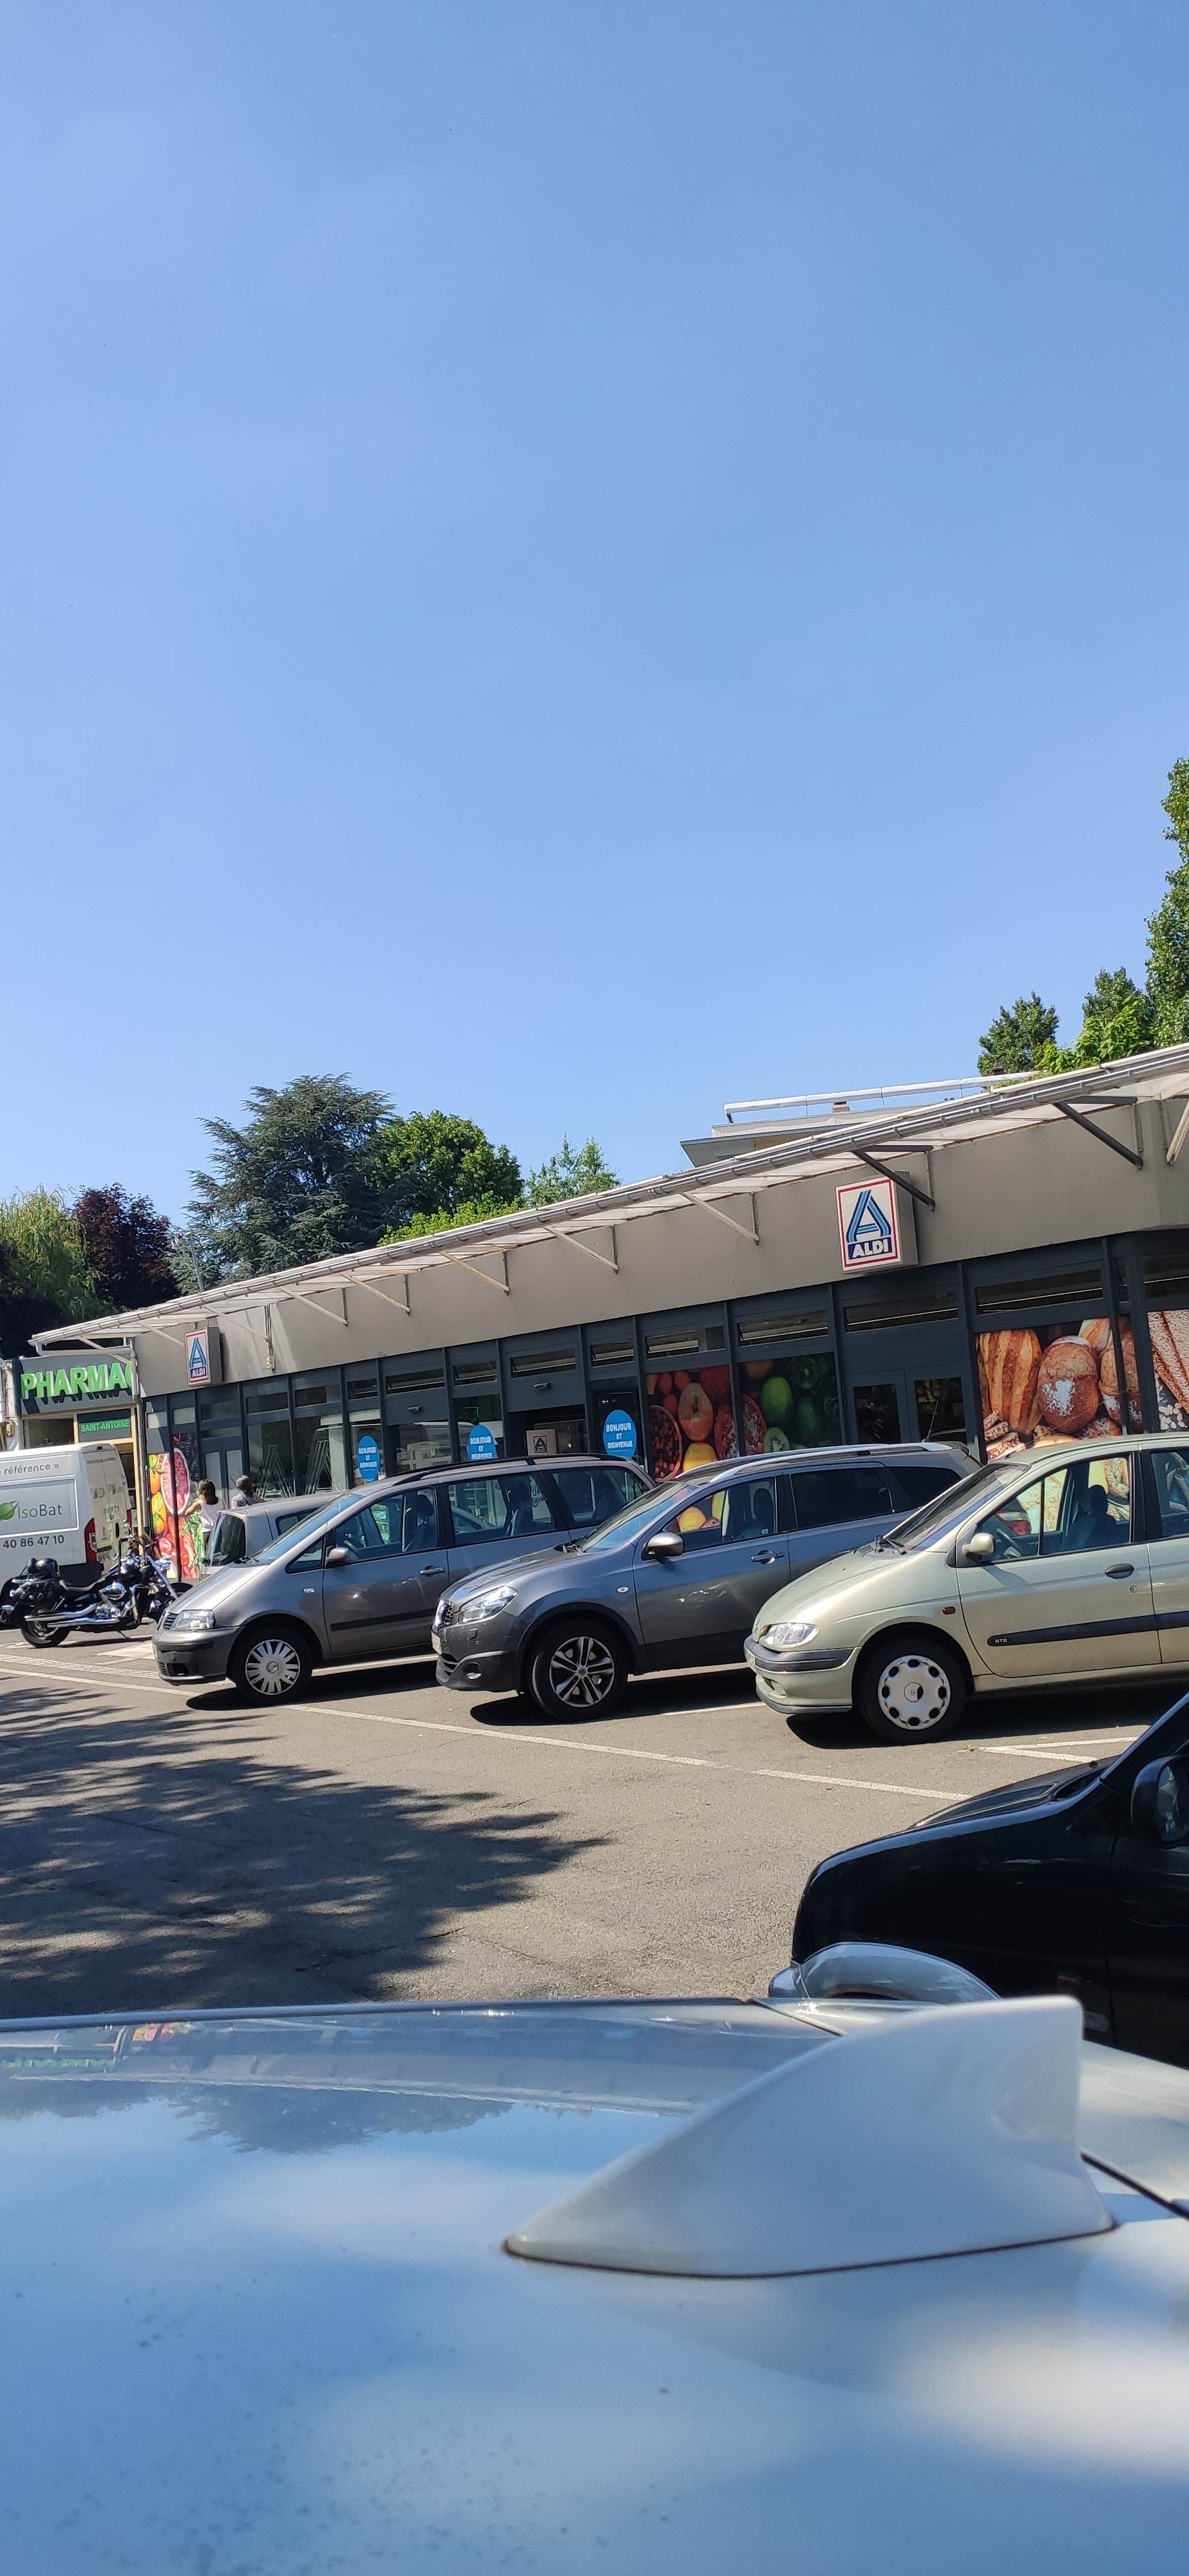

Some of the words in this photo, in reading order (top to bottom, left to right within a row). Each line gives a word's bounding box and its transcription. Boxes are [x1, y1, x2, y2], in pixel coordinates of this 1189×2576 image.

[852, 1238, 889, 1258] ALDI
[192, 1368, 205, 1378] ALDI
[81, 1419, 129, 1433] SAINT-ANTOINE
[606, 1423, 632, 1432] BONJOUR
[4, 1463, 51, 1475] référence
[17, 1504, 62, 1519] IsoBat
[3, 1539, 17, 1549] 40
[20, 1537, 34, 1548] 86
[37, 1536, 50, 1546] 47
[52, 1535, 64, 1544] 10
